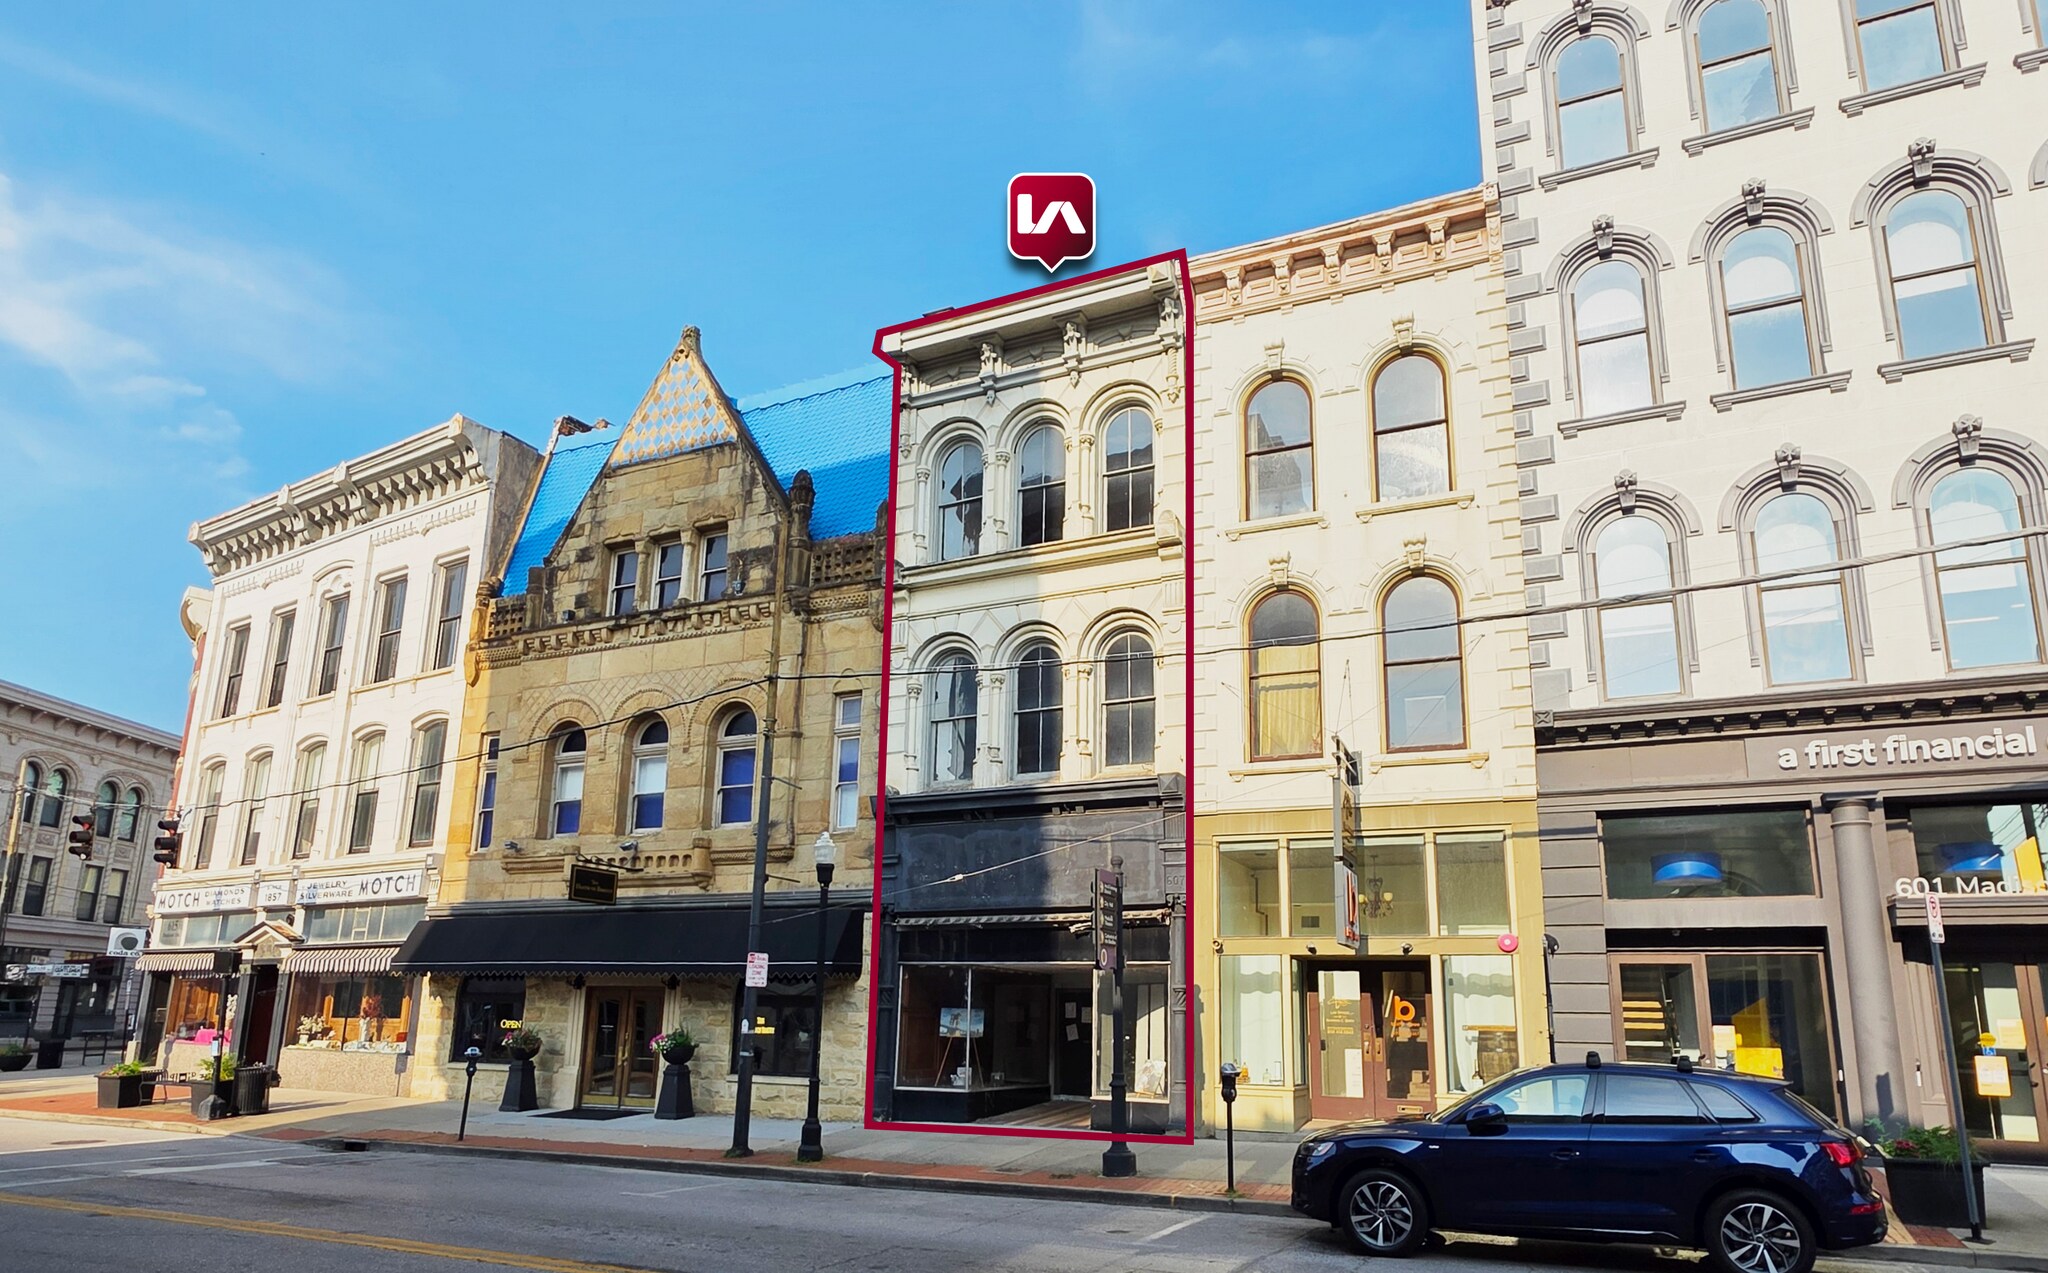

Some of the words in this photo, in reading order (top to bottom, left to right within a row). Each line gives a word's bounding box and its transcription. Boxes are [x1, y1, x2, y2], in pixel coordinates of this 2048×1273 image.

[1778, 747, 1799, 768] a
[1804, 738, 1878, 766] first
[1882, 725, 2038, 763] financial
[307, 880, 347, 890] JEWELRY
[359, 874, 417, 896] MOTCH
[1166, 874, 1185, 886] 607
[1895, 876, 1948, 898] 601
[1955, 874, 2048, 895] Madio
[204, 887, 245, 898] DIAMONDS
[265, 892, 282, 902] 1857
[300, 889, 353, 900] SILVERWARE
[158, 892, 200, 909] MOTCH
[206, 898, 241, 906] WATCHES
[500, 1019, 522, 1028] OPEN
